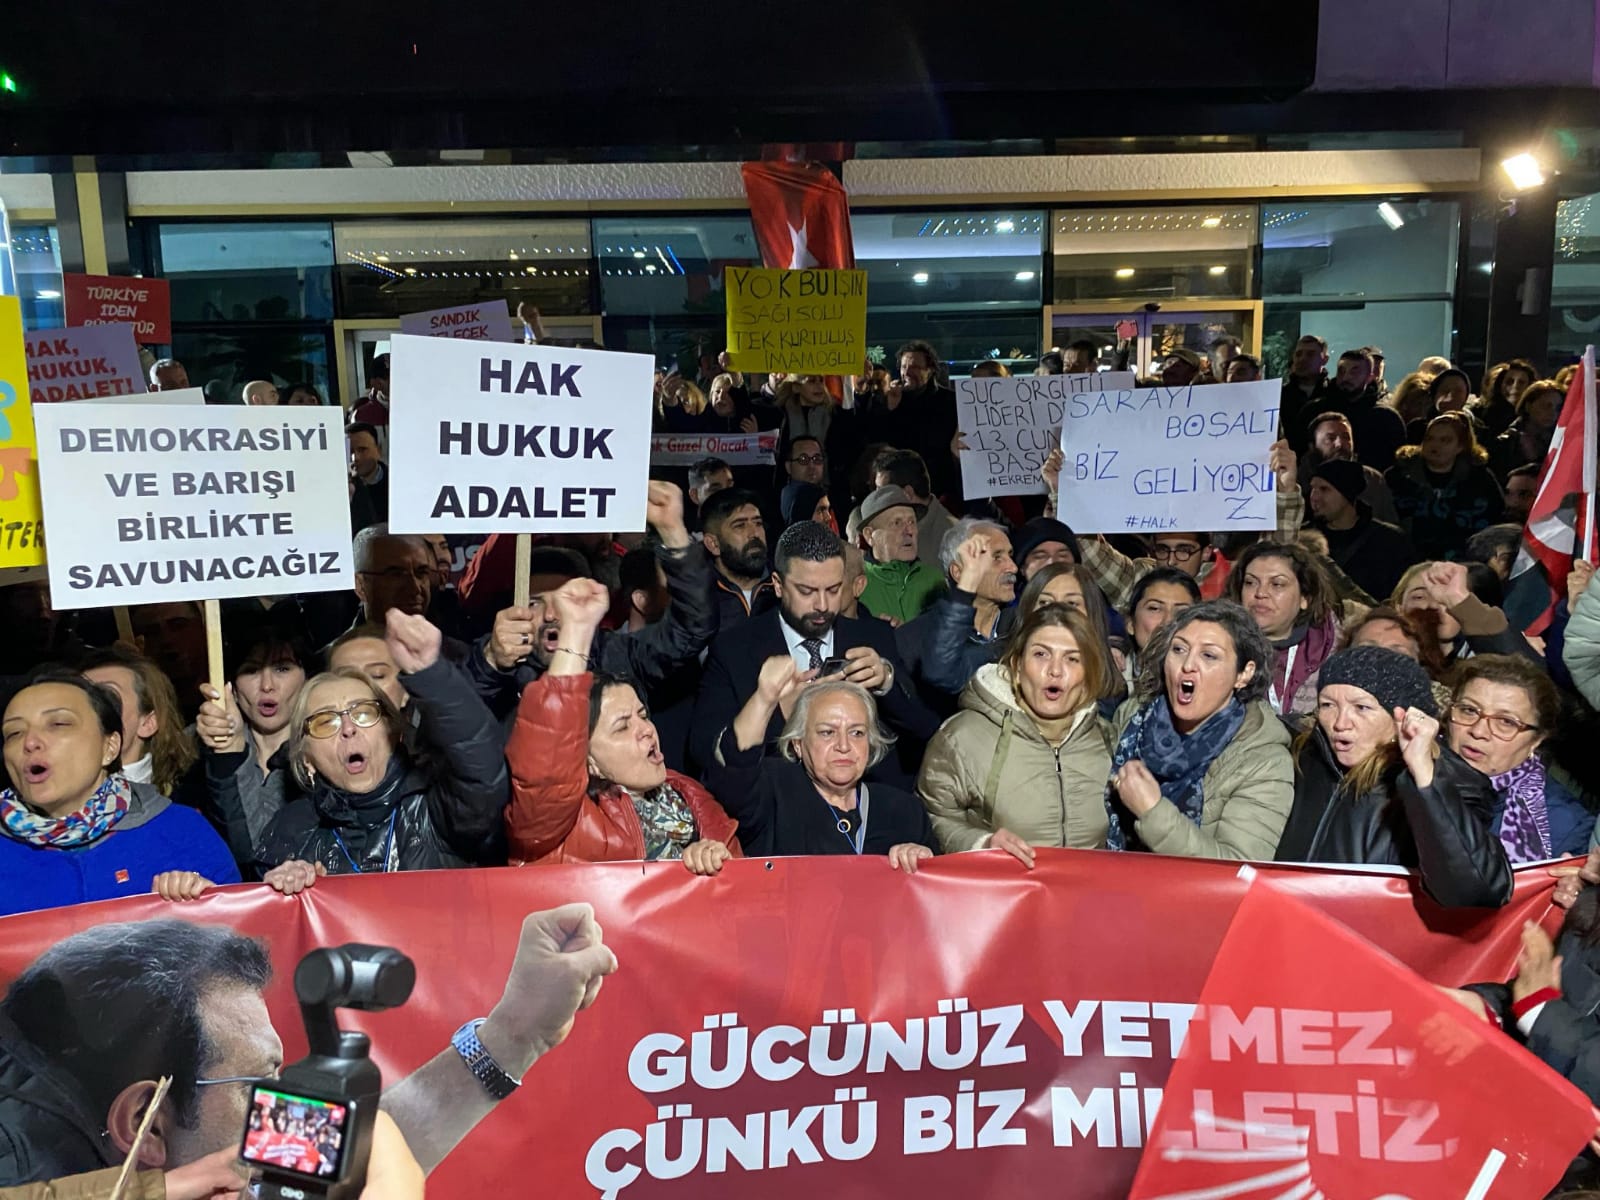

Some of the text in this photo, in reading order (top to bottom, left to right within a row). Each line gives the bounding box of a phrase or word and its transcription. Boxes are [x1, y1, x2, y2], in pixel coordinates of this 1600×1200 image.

[86, 286, 149, 302] TÜRKİYE
[734, 269, 791, 299] YOK
[800, 270, 829, 297] BU
[430, 309, 481, 329] SANDIK
[795, 304, 843, 321] SOLU
[735, 331, 774, 350] TEK
[28, 357, 117, 381] HUKUK,
[479, 357, 583, 398] HAK
[31, 377, 134, 403] ADALET!
[960, 381, 1005, 405] SUÇ
[974, 401, 1037, 427] LİDERİ
[1166, 408, 1280, 440] BOŞALT
[59, 423, 328, 453] DEMOKRASİYİ
[439, 421, 615, 461] HUKUK
[706, 437, 749, 453] Olacak
[973, 430, 1010, 452] 13.
[1075, 444, 1119, 481] BİZ
[104, 470, 296, 499] VE BARIŞI
[430, 485, 617, 519] ADALET
[1225, 495, 1267, 521] Z
[118, 509, 294, 542] BİRLİKTE
[1125, 515, 1178, 529] #HALK
[68, 548, 341, 590] SAVUNACAĞIZ
[627, 997, 1028, 1094] GÜCÜNÜZ
[585, 1086, 878, 1200] ÇÜNKÜ
[903, 1079, 1028, 1156] BİZ
